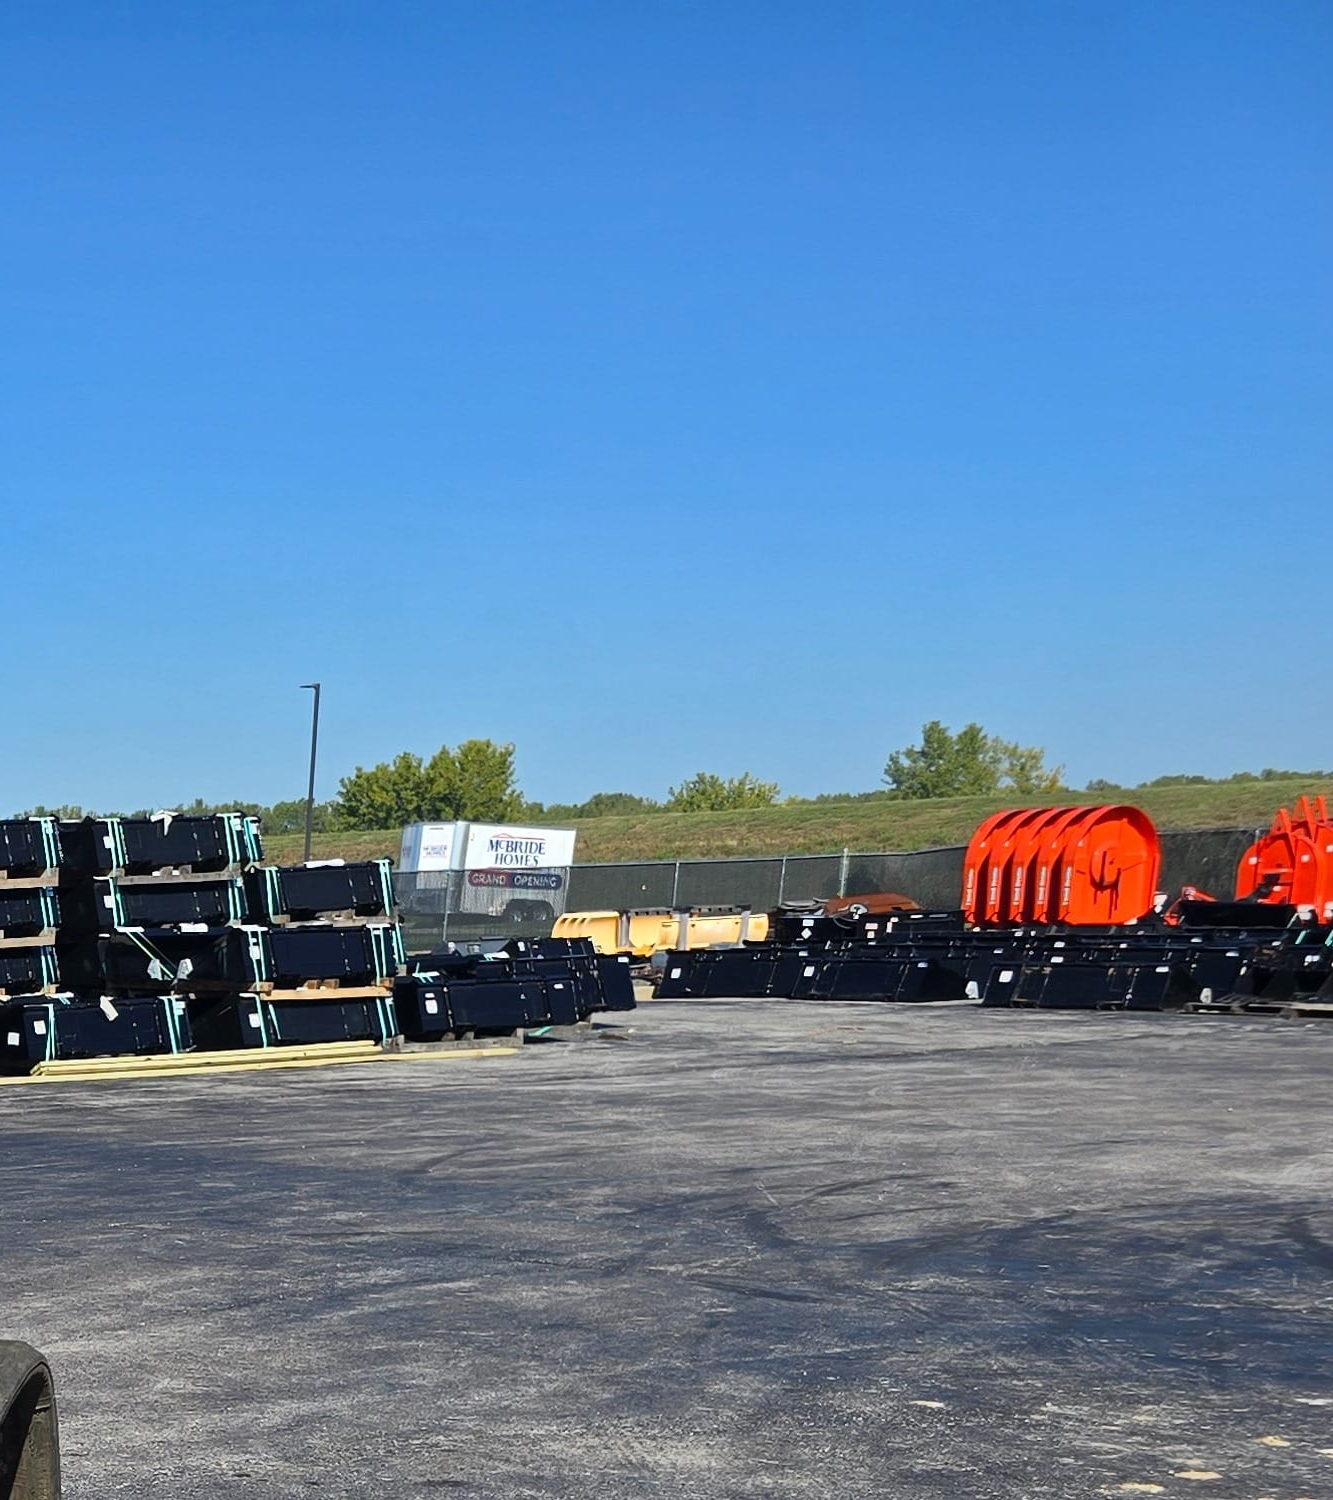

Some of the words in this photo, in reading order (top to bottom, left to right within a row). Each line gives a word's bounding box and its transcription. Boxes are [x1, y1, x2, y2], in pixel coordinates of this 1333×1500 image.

[494, 853, 539, 866] HOMES
[472, 873, 507, 885] GRAND
[514, 874, 558, 887] OPENING
